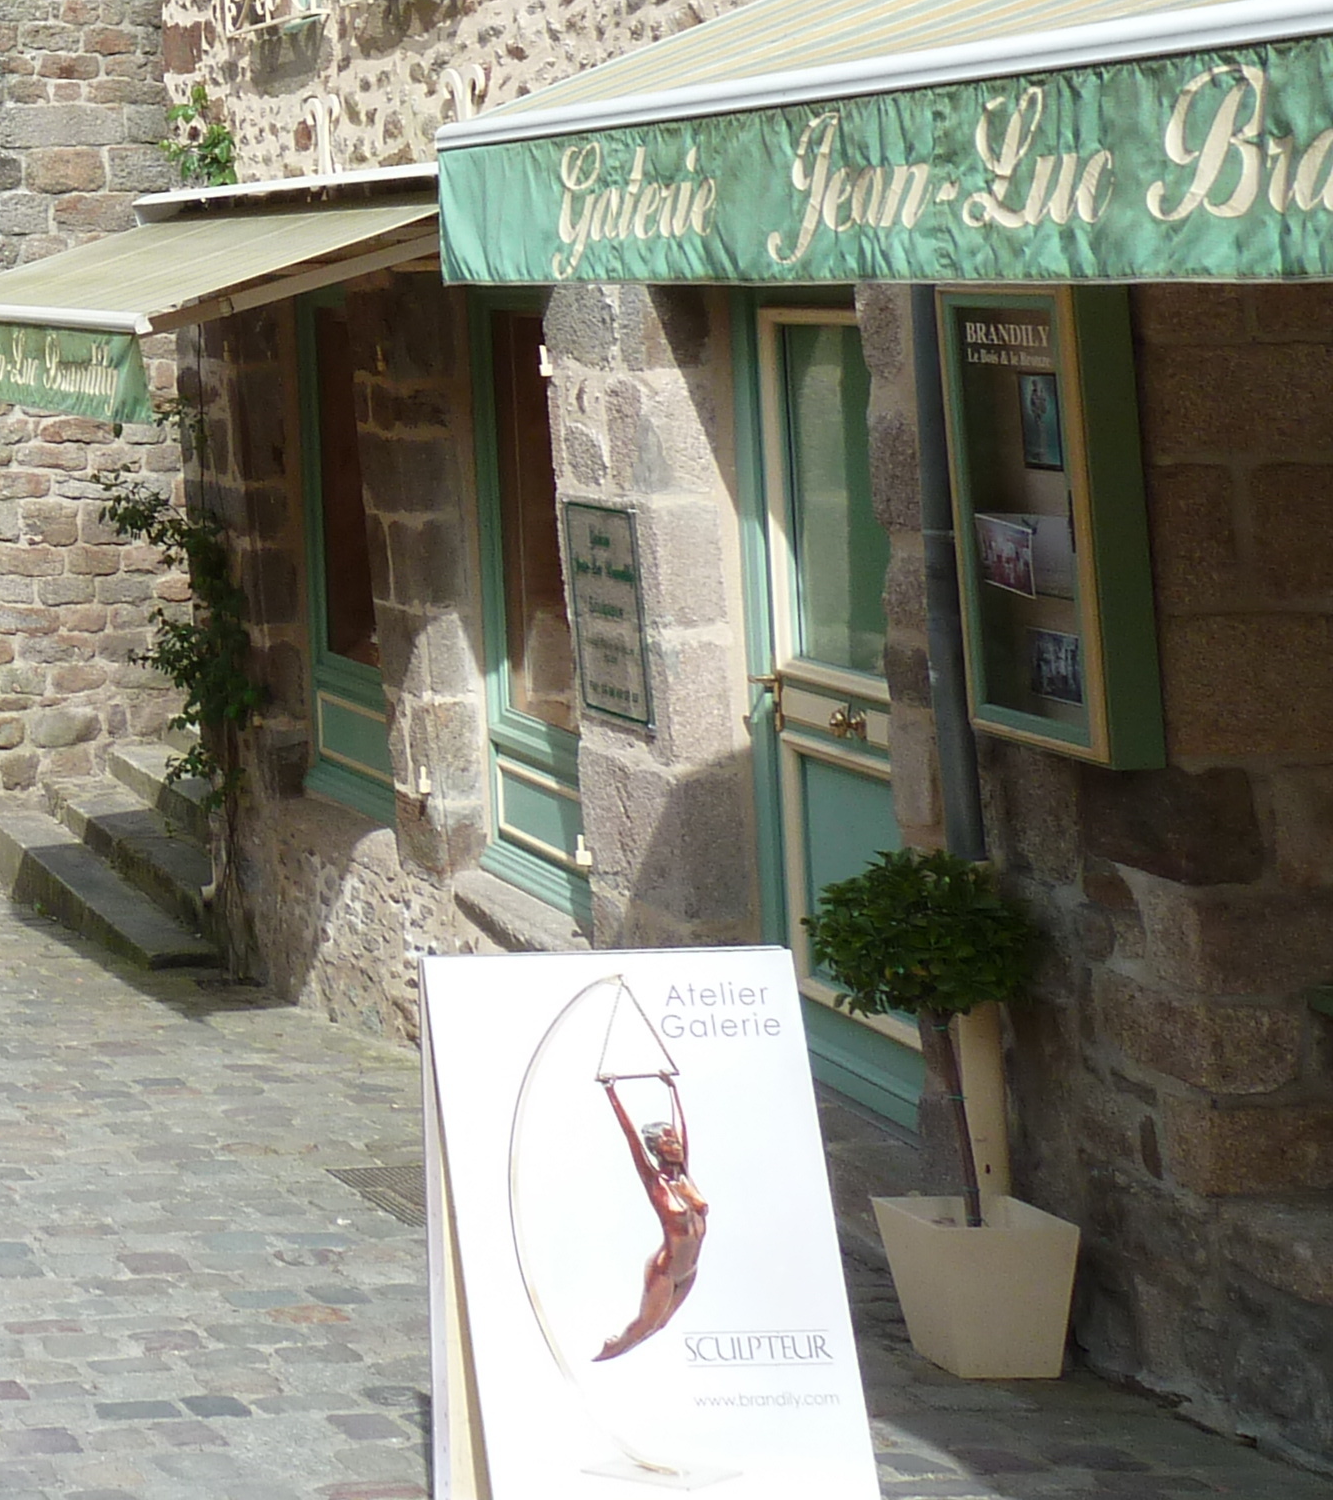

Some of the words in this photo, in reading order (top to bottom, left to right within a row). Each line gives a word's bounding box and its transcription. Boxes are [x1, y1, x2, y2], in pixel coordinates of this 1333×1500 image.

[552, 141, 715, 279] Galerie
[965, 321, 1050, 347] BRANDILY
[665, 981, 769, 1007] Atelier
[660, 1012, 781, 1039] Galerie
[684, 1334, 834, 1362] SCULPTEUR
[693, 1392, 841, 1409] www.brandily.com
